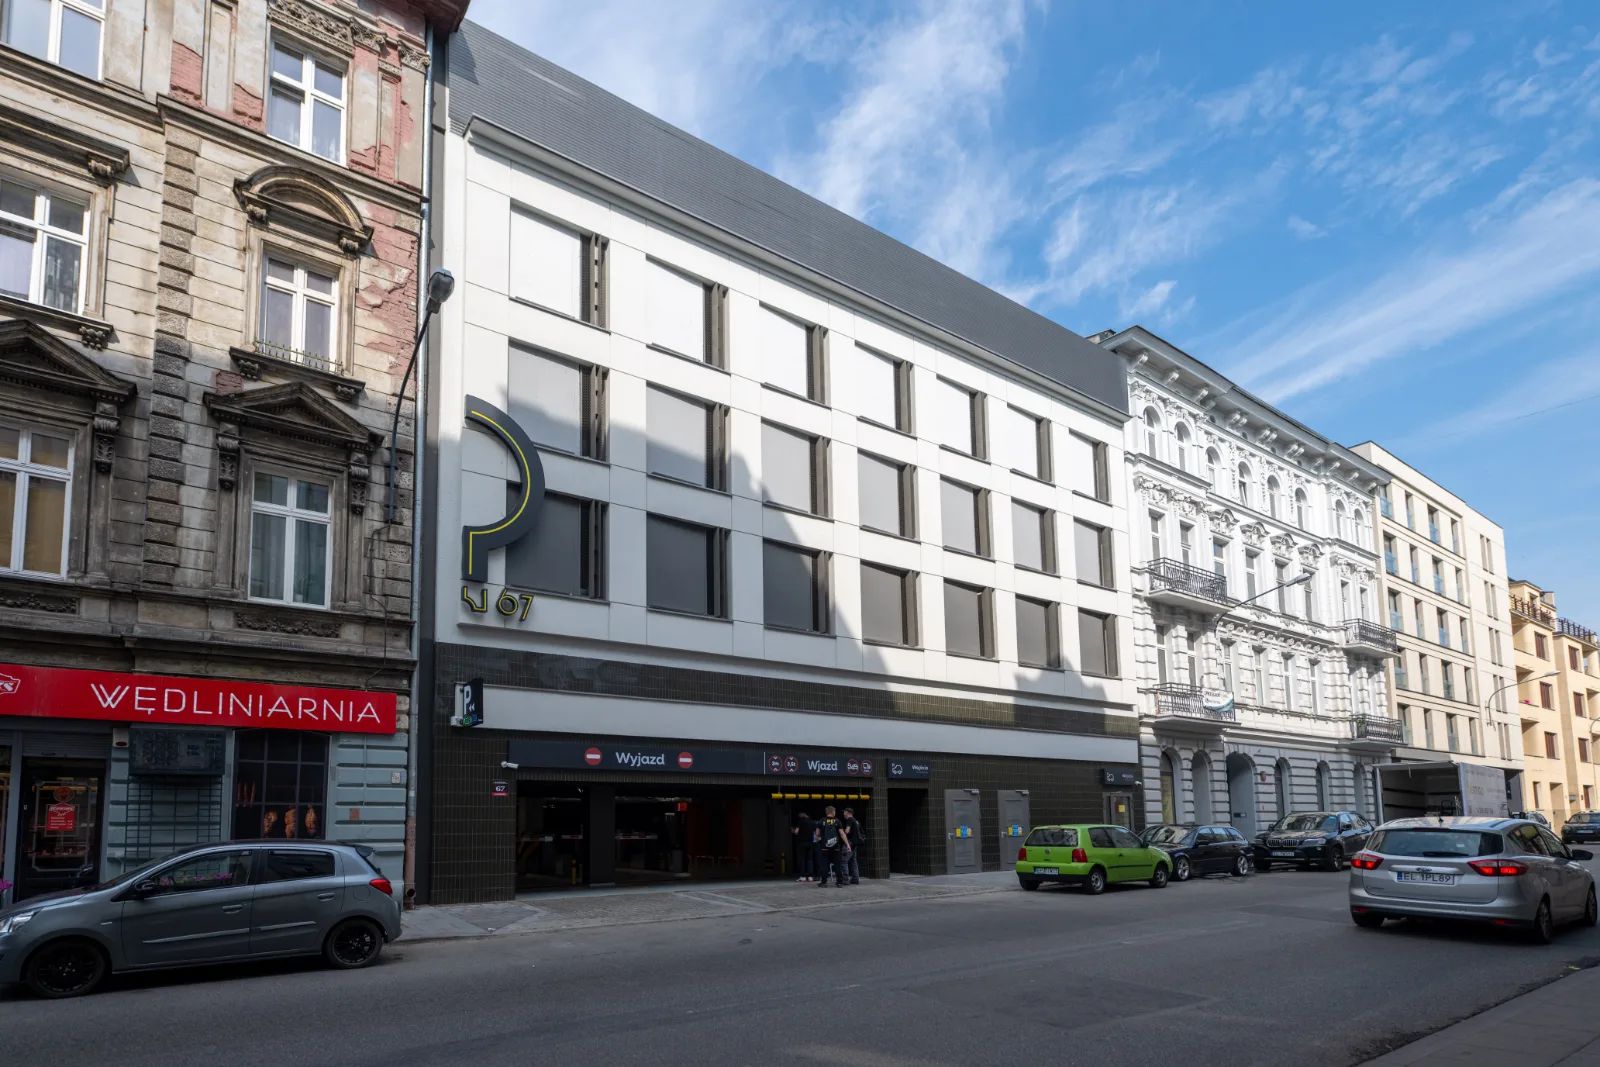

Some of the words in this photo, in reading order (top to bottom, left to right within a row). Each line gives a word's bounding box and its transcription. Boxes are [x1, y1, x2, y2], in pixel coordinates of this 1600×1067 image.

[90, 683, 381, 724] WĘDLINIARNIA
[615, 751, 665, 767] Wyjazd
[807, 760, 838, 773] Wjazd
[1404, 872, 1416, 881] EL
[1421, 873, 1451, 883] 1PL89
